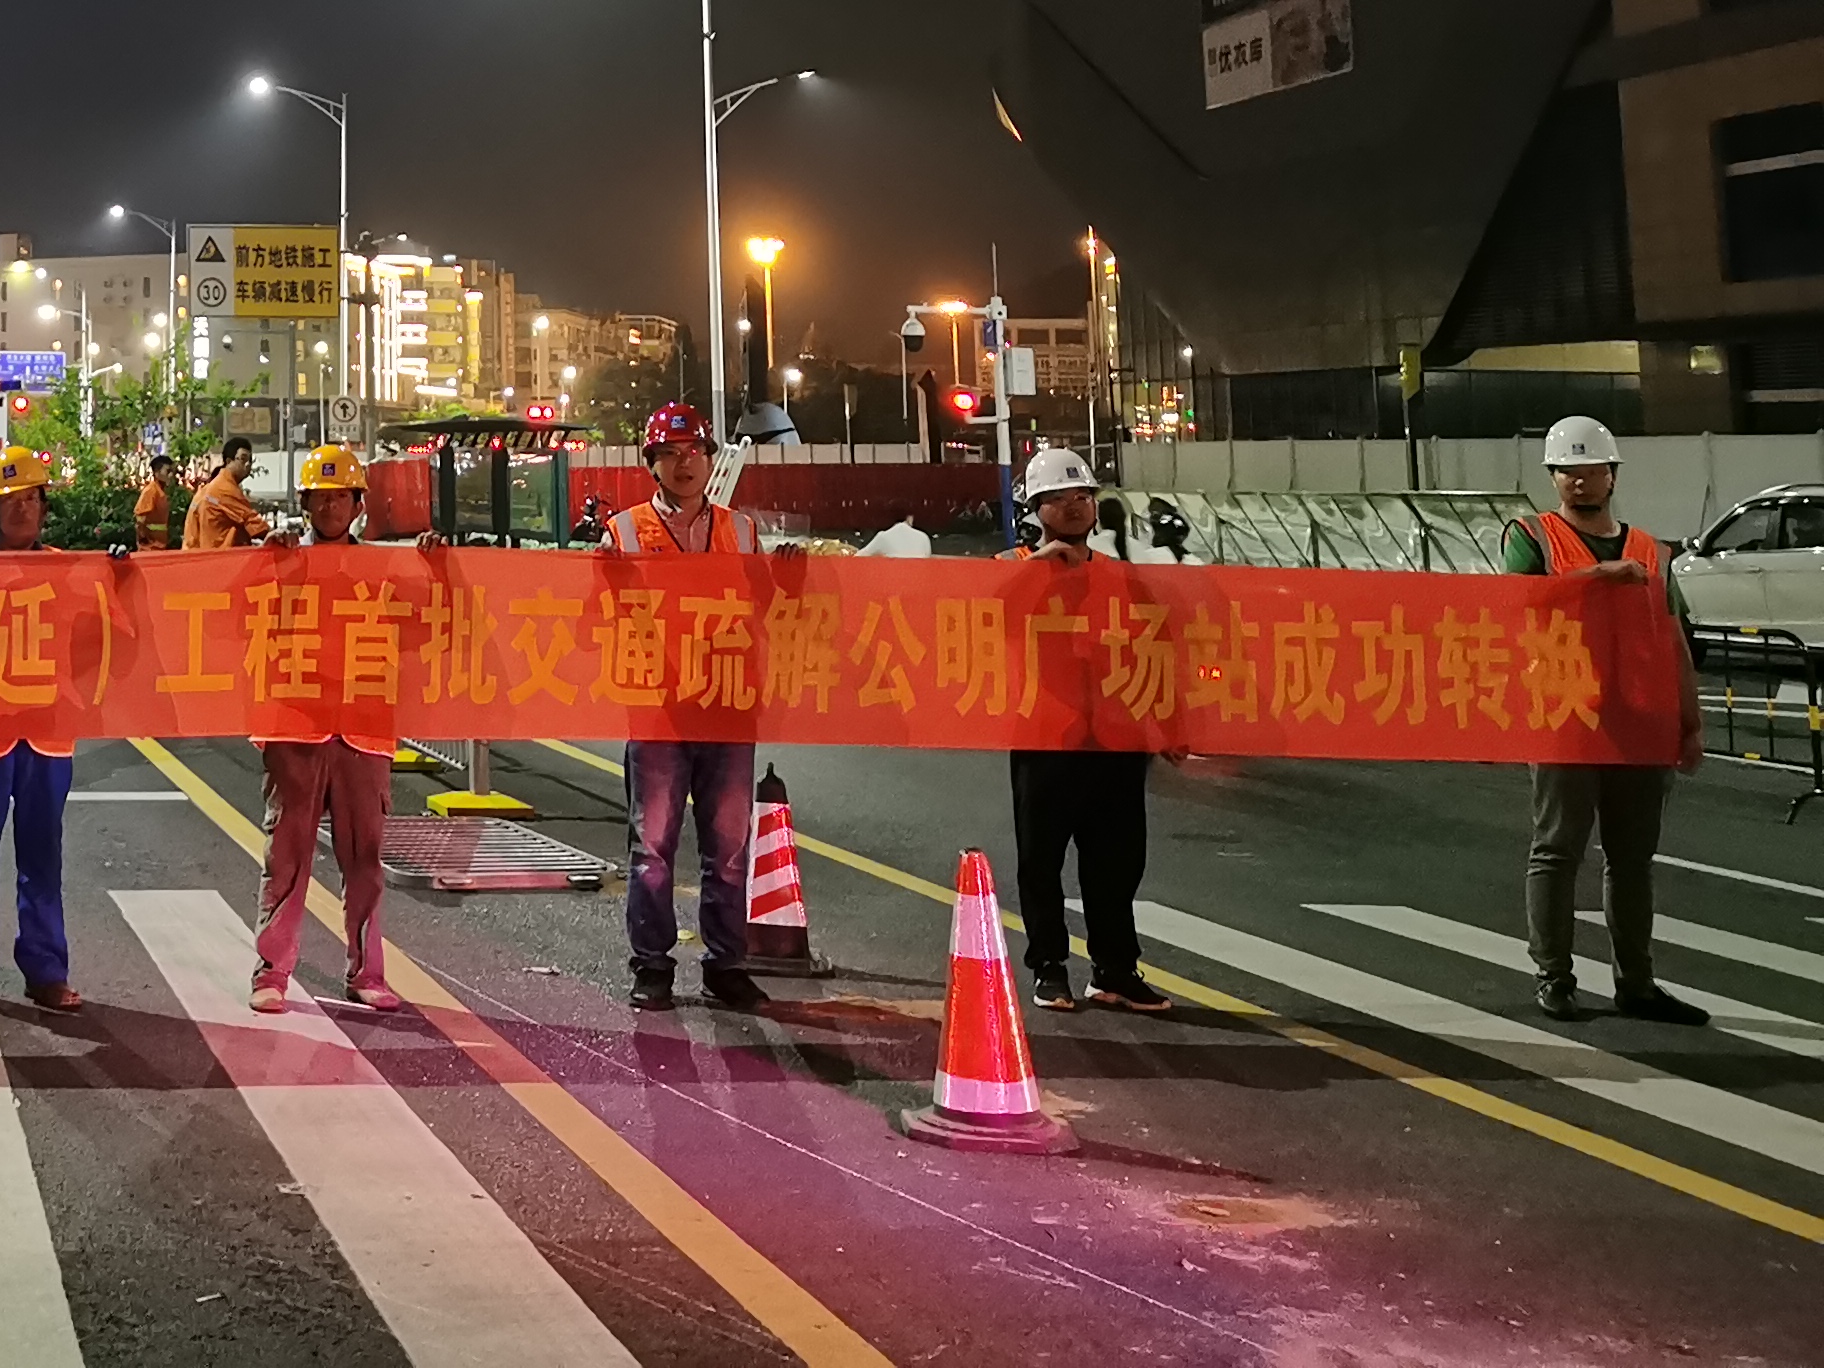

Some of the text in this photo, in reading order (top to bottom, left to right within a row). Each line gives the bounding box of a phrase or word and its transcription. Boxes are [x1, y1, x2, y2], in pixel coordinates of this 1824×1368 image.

[235, 244, 332, 268] 前方地铁施工
[203, 285, 220, 301] 30
[236, 280, 332, 304] 车辆减速慢行
